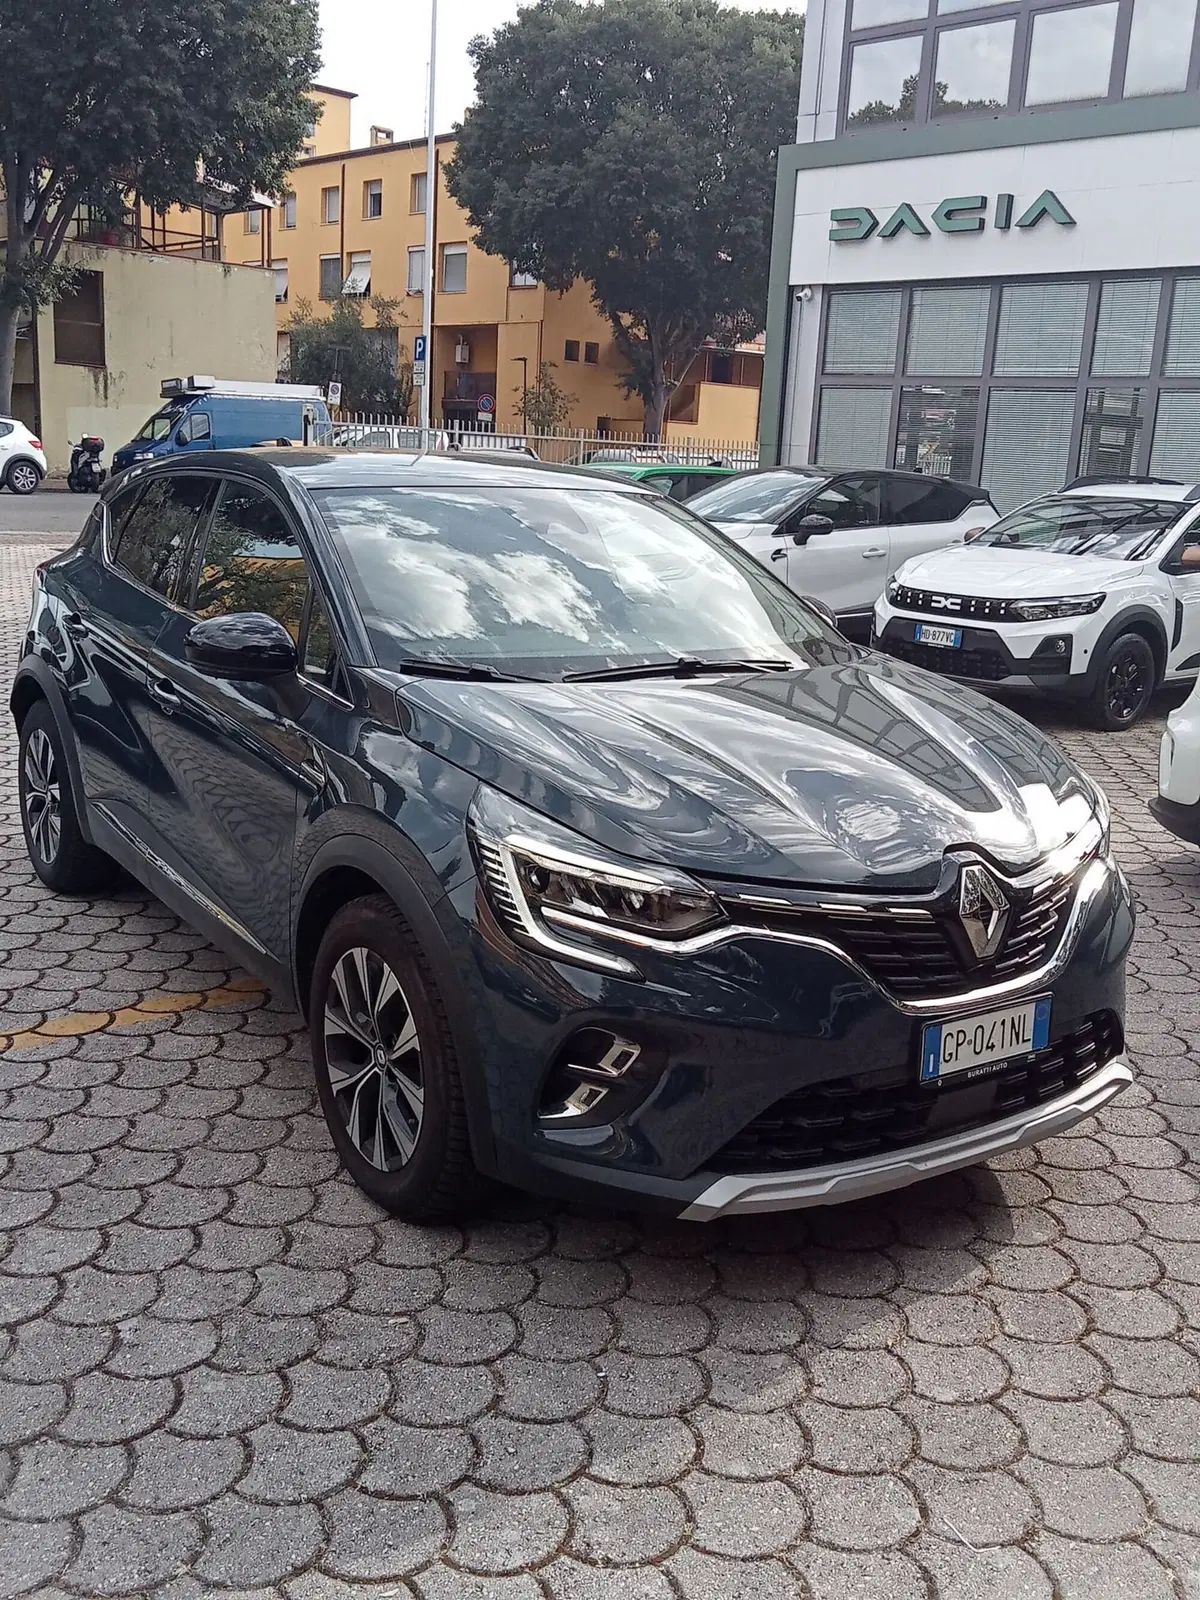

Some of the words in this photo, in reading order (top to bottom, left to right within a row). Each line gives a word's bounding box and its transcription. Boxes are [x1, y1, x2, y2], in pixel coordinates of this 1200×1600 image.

[829, 189, 1077, 241] DACIA
[416, 339, 423, 358] P
[967, 1067, 992, 1078] BURATTI
[992, 1061, 1008, 1072] AUTO
